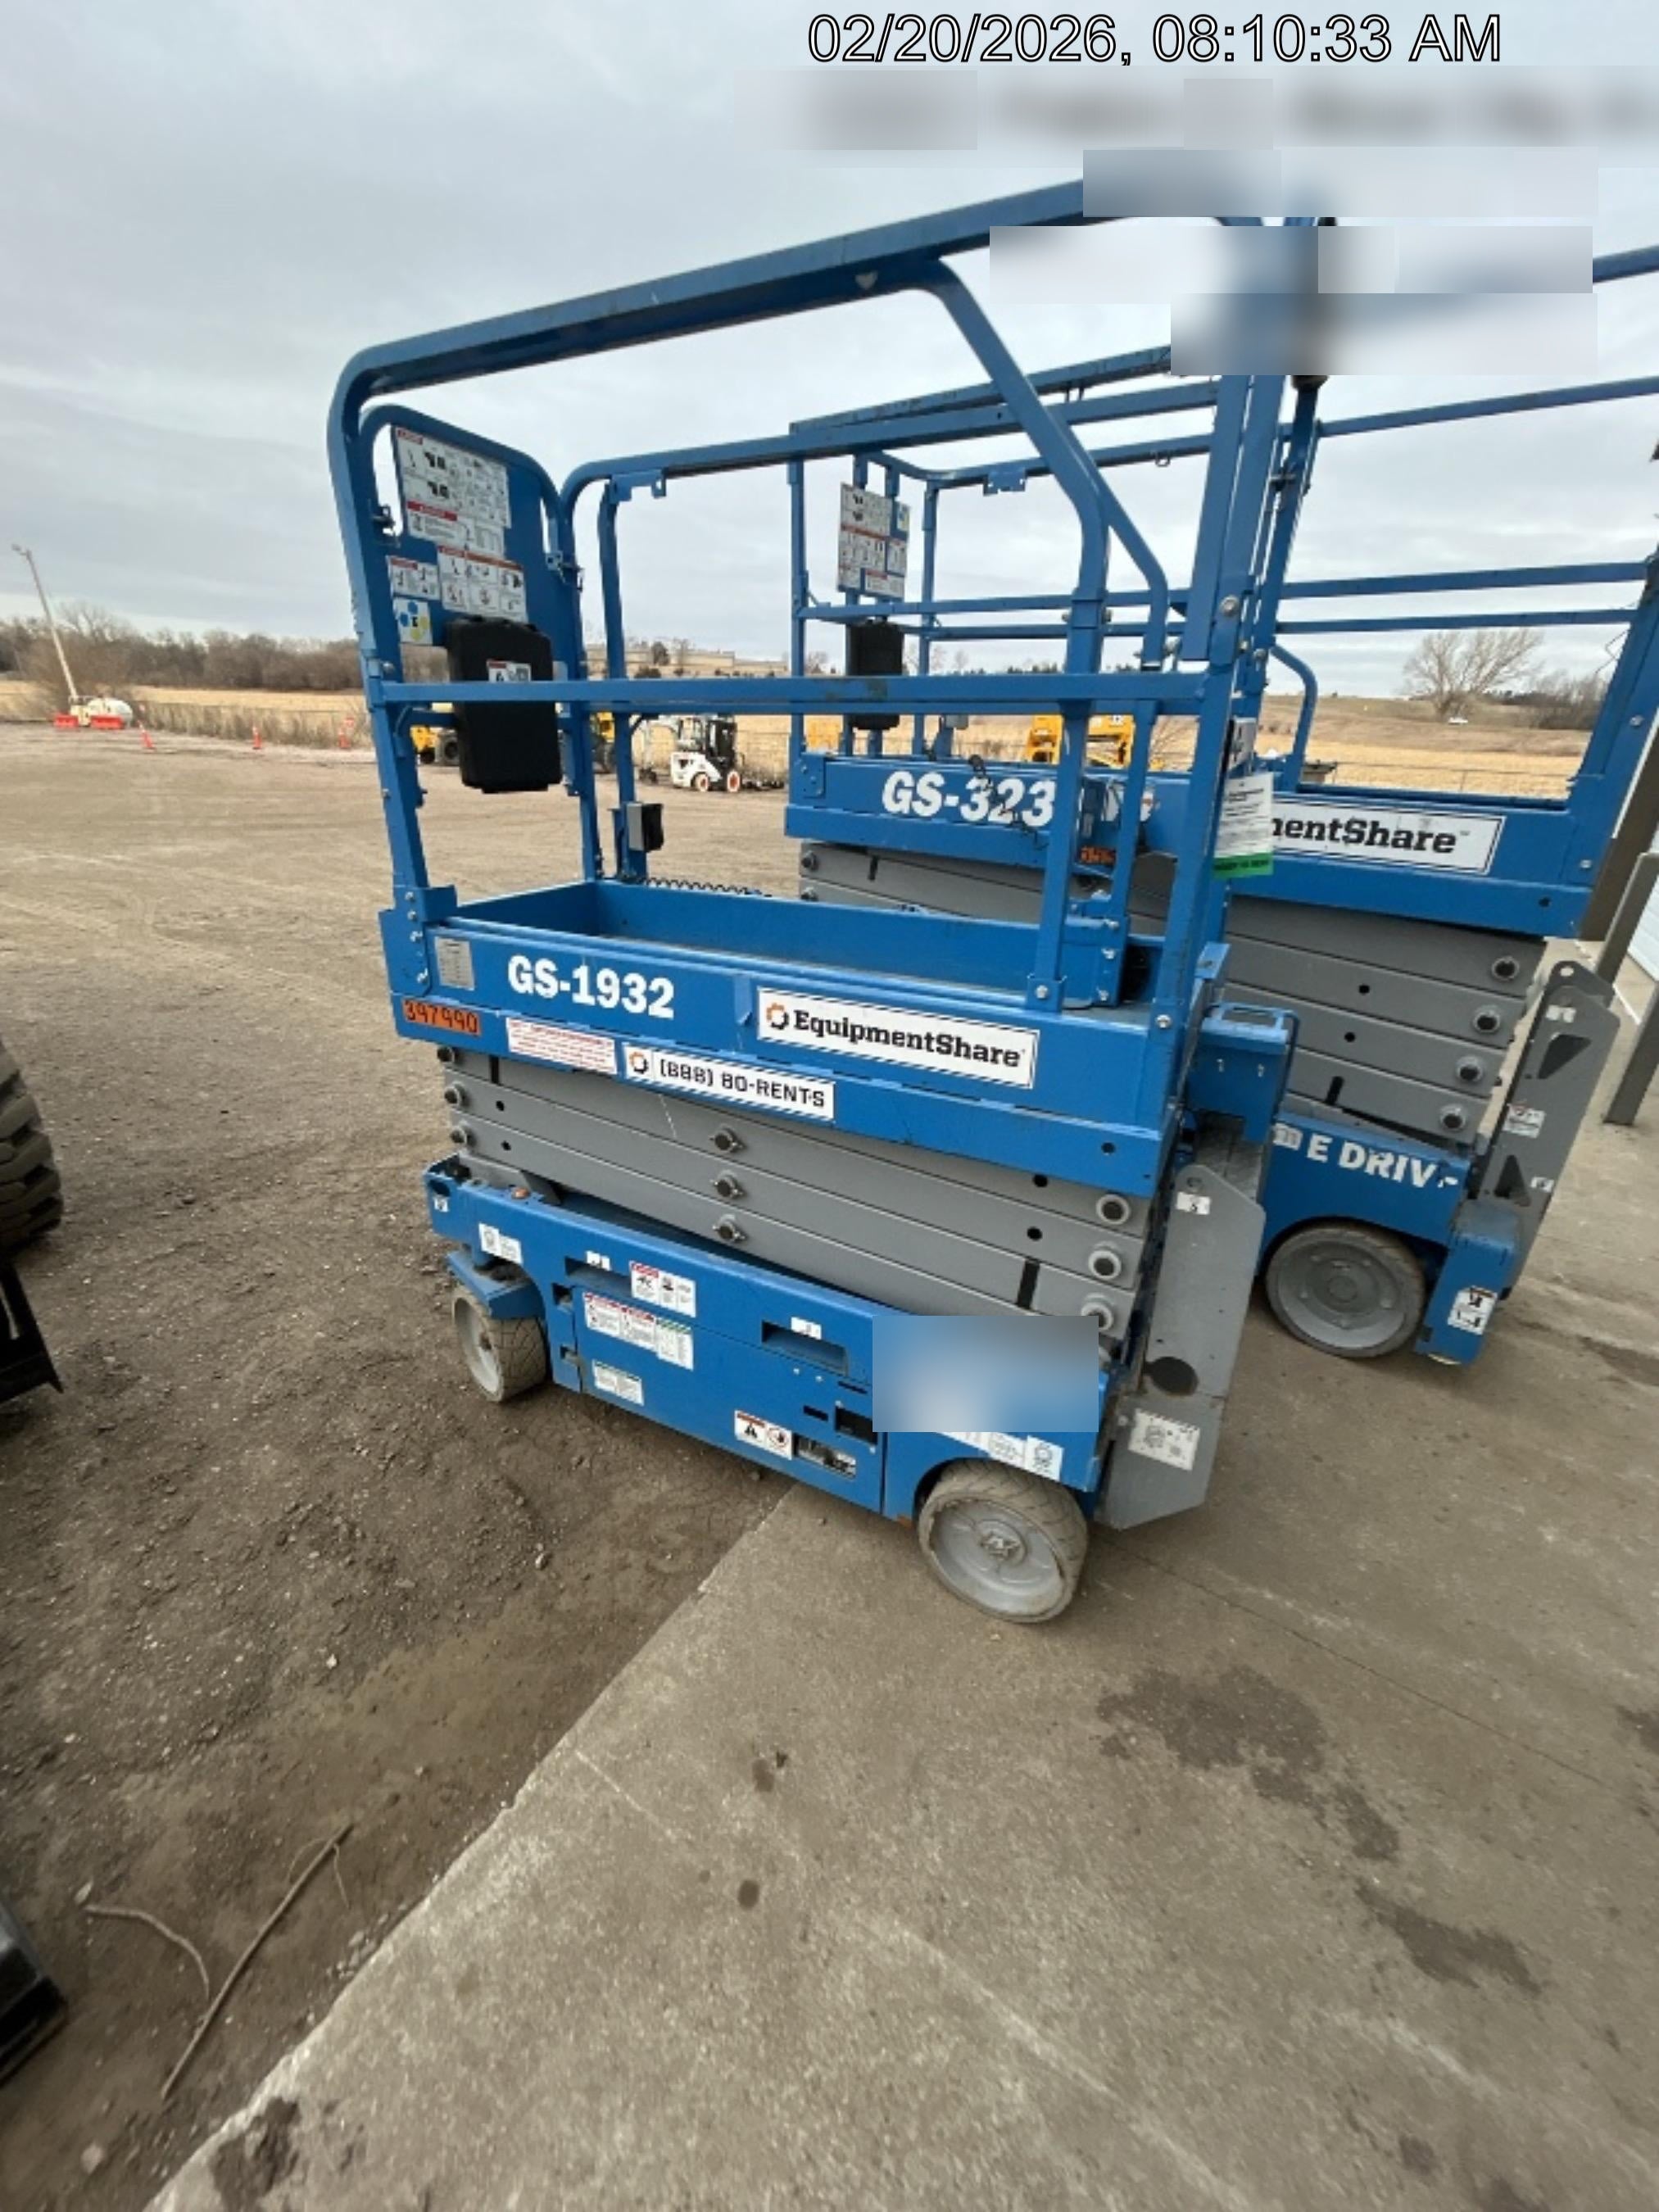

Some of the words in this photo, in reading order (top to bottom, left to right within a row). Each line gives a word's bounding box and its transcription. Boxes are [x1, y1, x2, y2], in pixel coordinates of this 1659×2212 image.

[508, 954, 674, 1019] GS-1932
[404, 999, 478, 1033] 397990
[794, 1009, 1020, 1067] EquipmentShare
[721, 1072, 825, 1107] 80-RENTS
